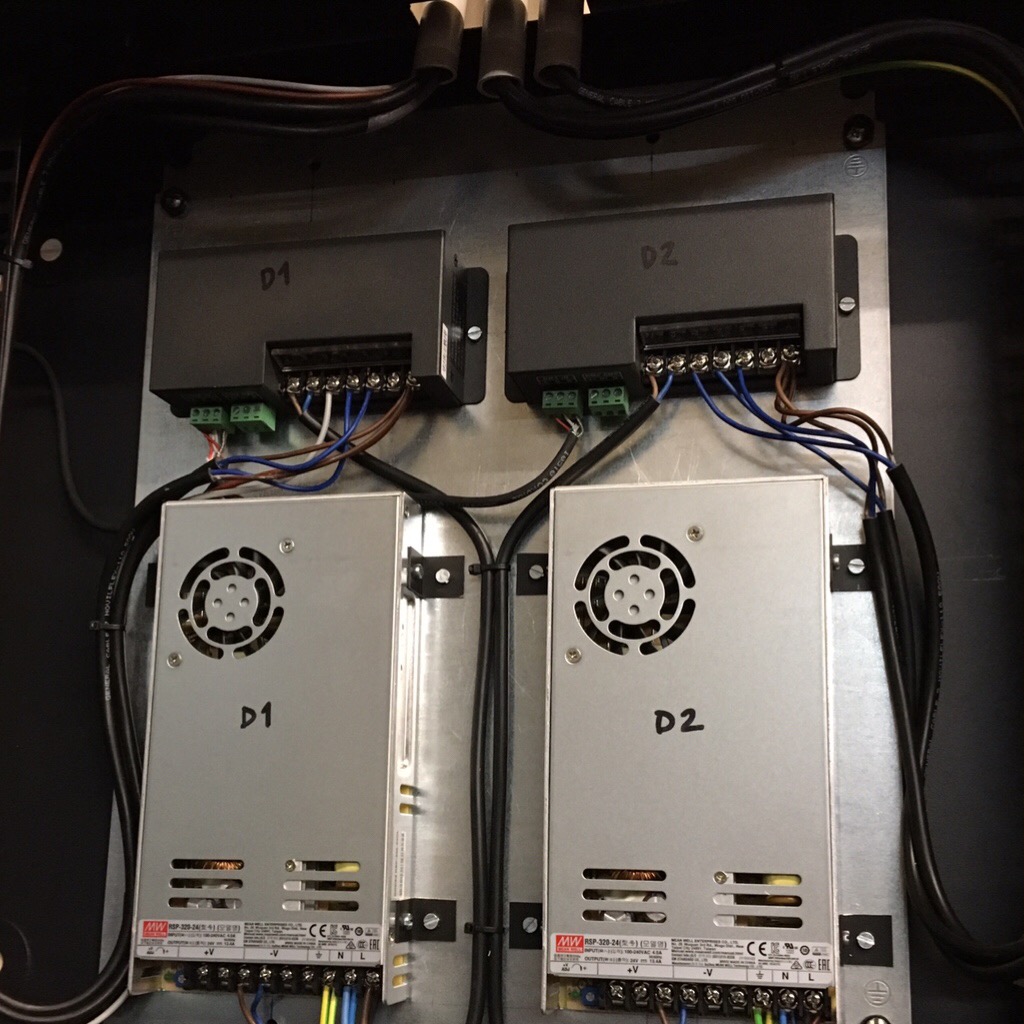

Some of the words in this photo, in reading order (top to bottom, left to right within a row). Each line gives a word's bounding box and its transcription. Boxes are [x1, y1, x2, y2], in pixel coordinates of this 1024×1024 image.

[640, 240, 679, 270] D2
[260, 260, 291, 291] D1
[240, 700, 272, 729] D1
[654, 708, 705, 735] D2
[747, 941, 767, 957] CE
[337, 951, 344, 959] N
[360, 952, 366, 960] L
[627, 965, 639, 974] +V
[703, 968, 713, 977] -V
[781, 972, 789, 980] N
[808, 973, 815, 981] L
